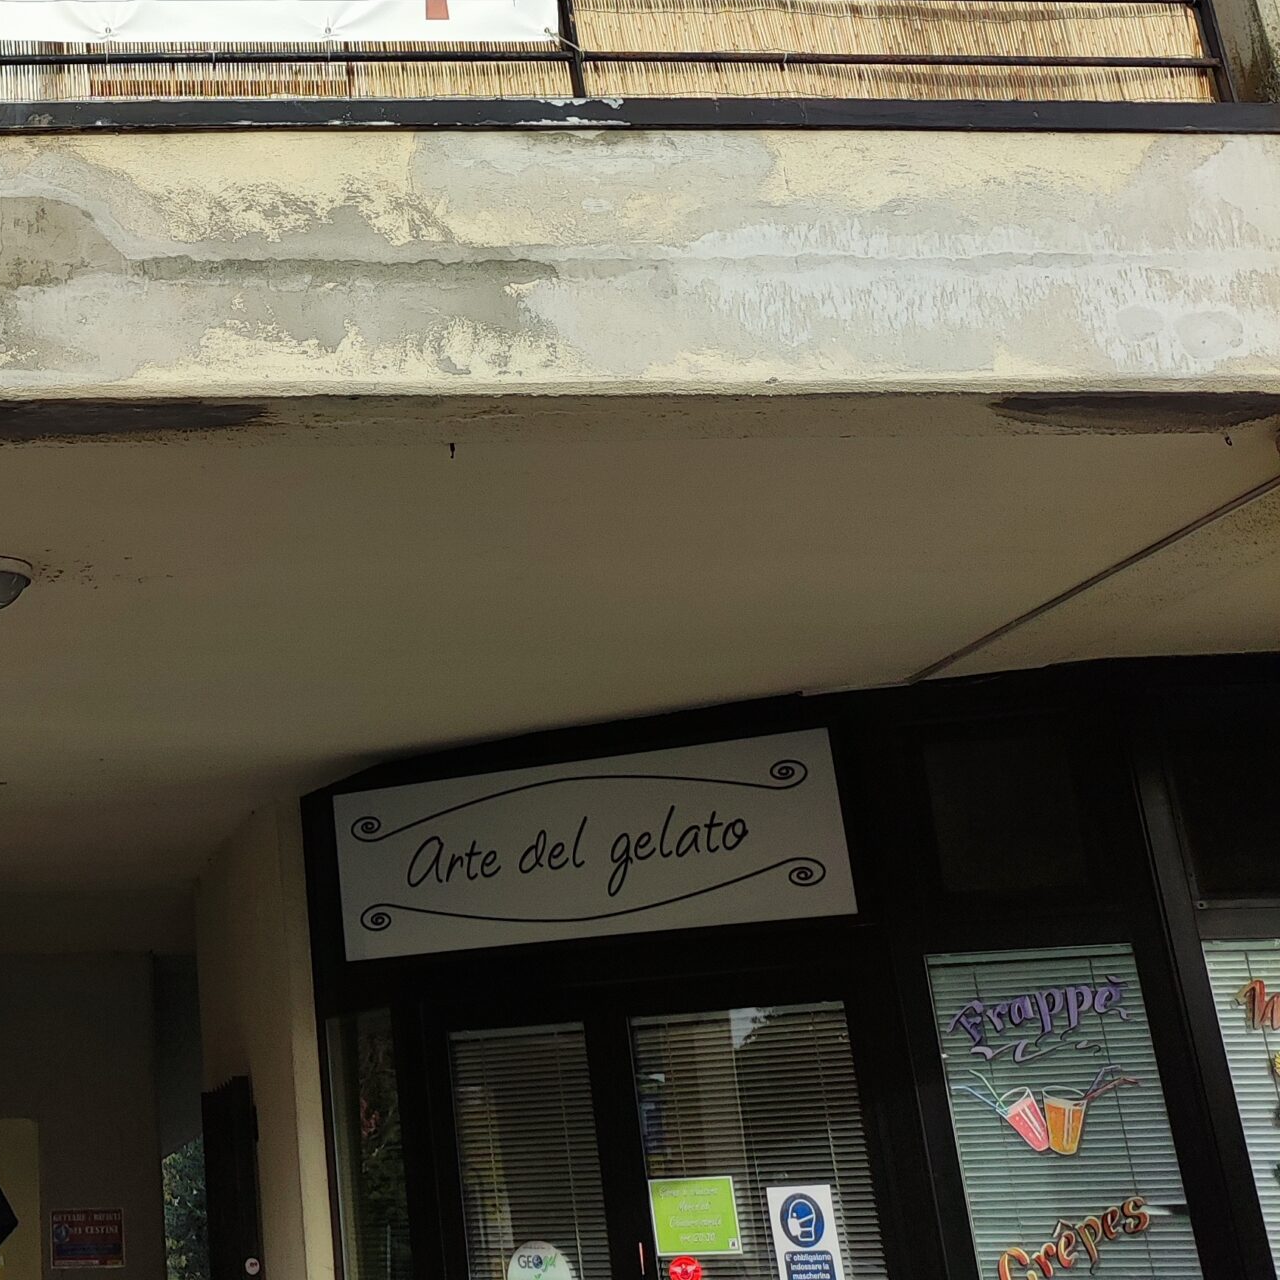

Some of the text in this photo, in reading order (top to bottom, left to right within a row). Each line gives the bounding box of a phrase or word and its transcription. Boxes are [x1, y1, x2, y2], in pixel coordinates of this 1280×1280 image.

[406, 806, 750, 897] Arte del gelato
